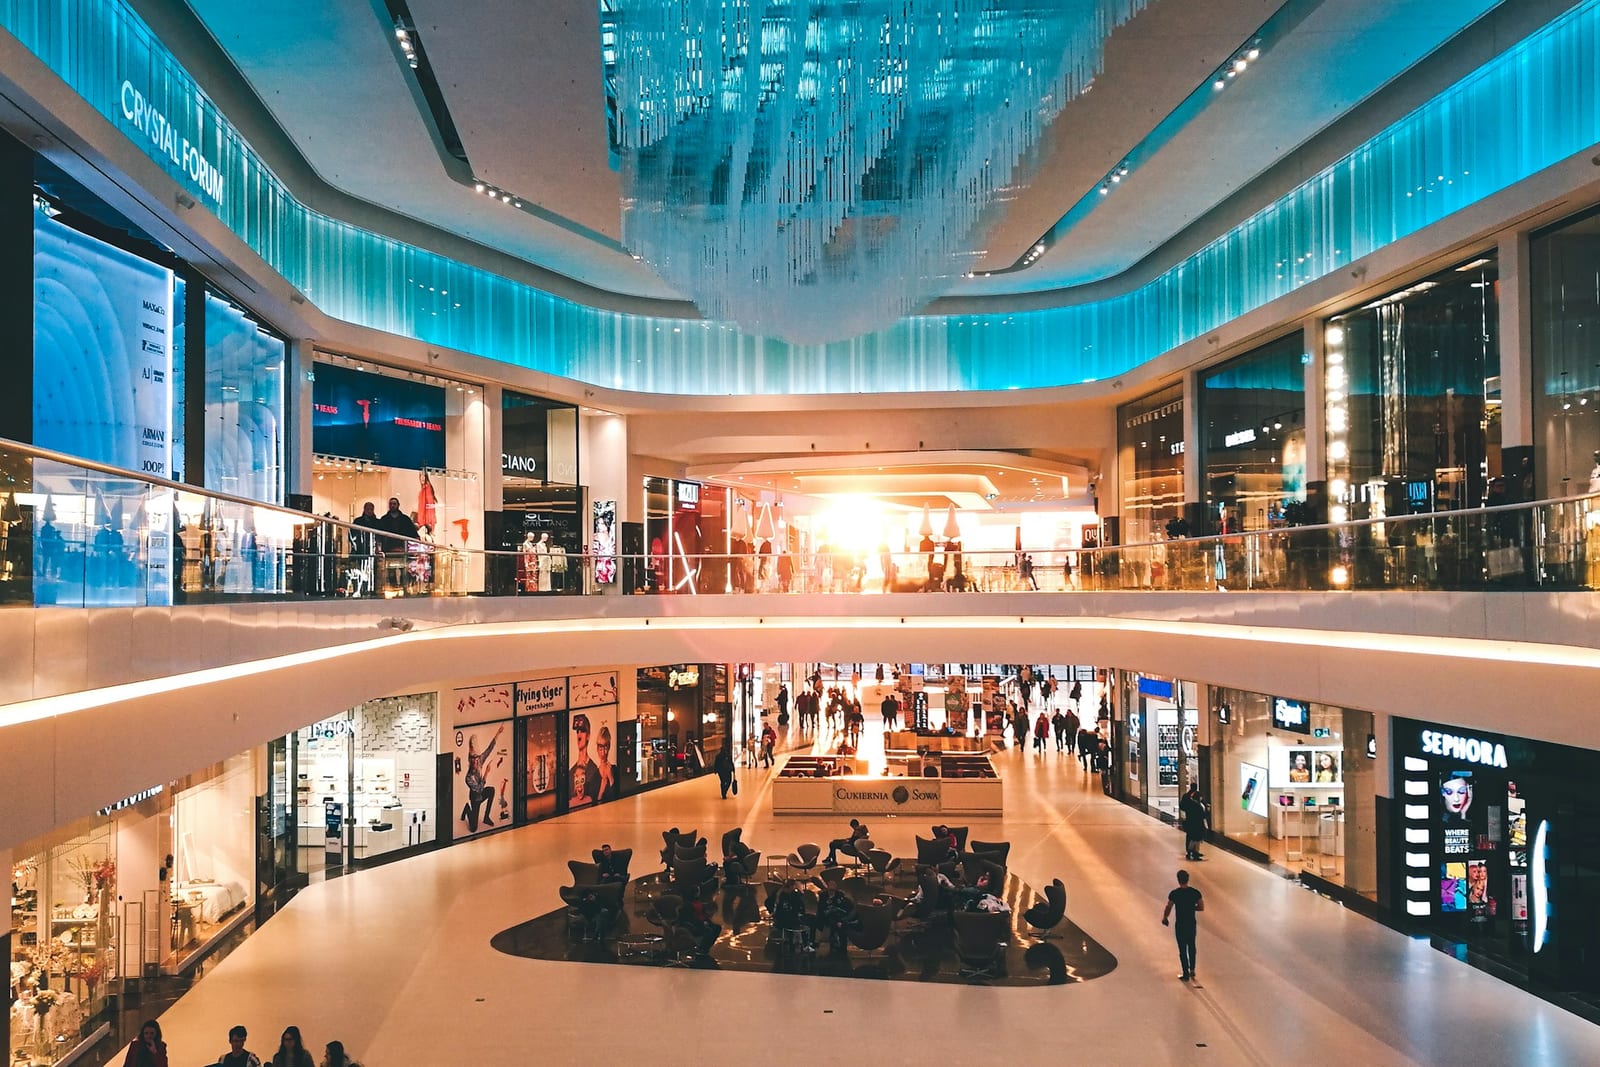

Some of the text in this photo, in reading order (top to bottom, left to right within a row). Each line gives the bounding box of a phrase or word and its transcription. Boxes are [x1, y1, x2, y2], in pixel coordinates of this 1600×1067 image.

[121, 79, 224, 207] CRYSTAL FORUM
[142, 427, 165, 442] ARMANI
[142, 459, 165, 474] JOOP!
[522, 519, 569, 529] MARIANO
[542, 685, 564, 700] tiger
[525, 702, 554, 711] copenhagen
[1422, 729, 1508, 769] SEPHORA
[836, 788, 939, 801] CUKIERNIA SOWA
[1444, 845, 1470, 854] BEATS
